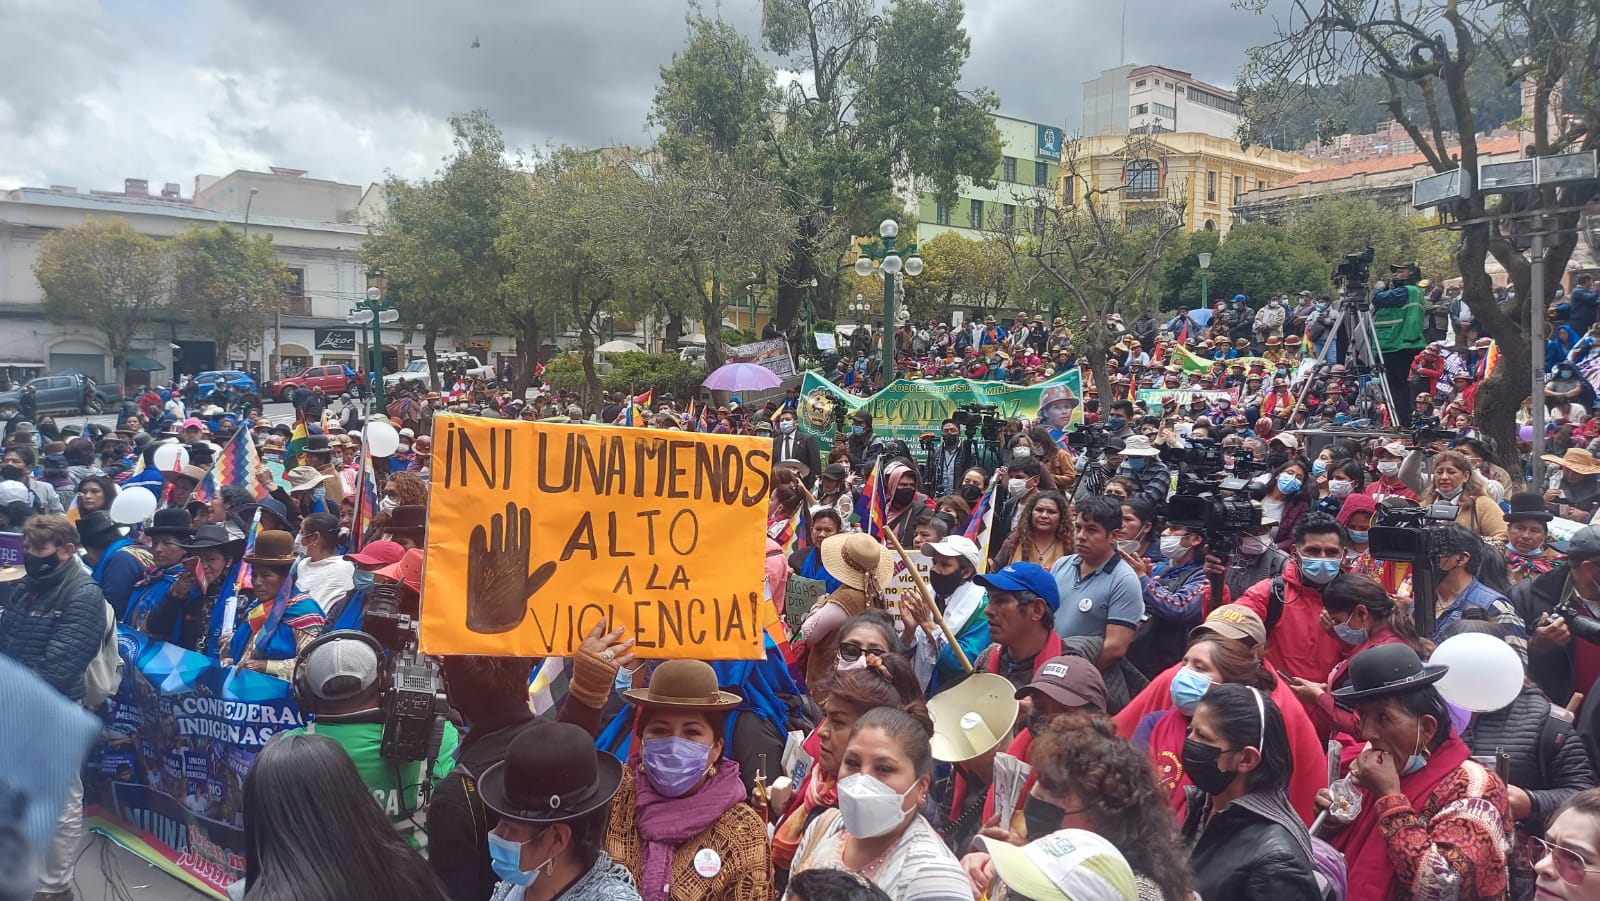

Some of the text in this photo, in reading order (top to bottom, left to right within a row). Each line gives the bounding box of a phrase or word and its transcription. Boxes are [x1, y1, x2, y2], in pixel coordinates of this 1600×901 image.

[444, 422, 771, 508] ¡NI UNA MENOS
[559, 508, 699, 562] ALTO
[0, 547, 18, 561] RE
[917, 563, 928, 572] La
[612, 563, 690, 595] A LA
[885, 587, 898, 595] no
[529, 591, 758, 653] VIOLENCIA!
[183, 697, 304, 726] CONFEDERA
[178, 718, 273, 746] INDIGENAS
